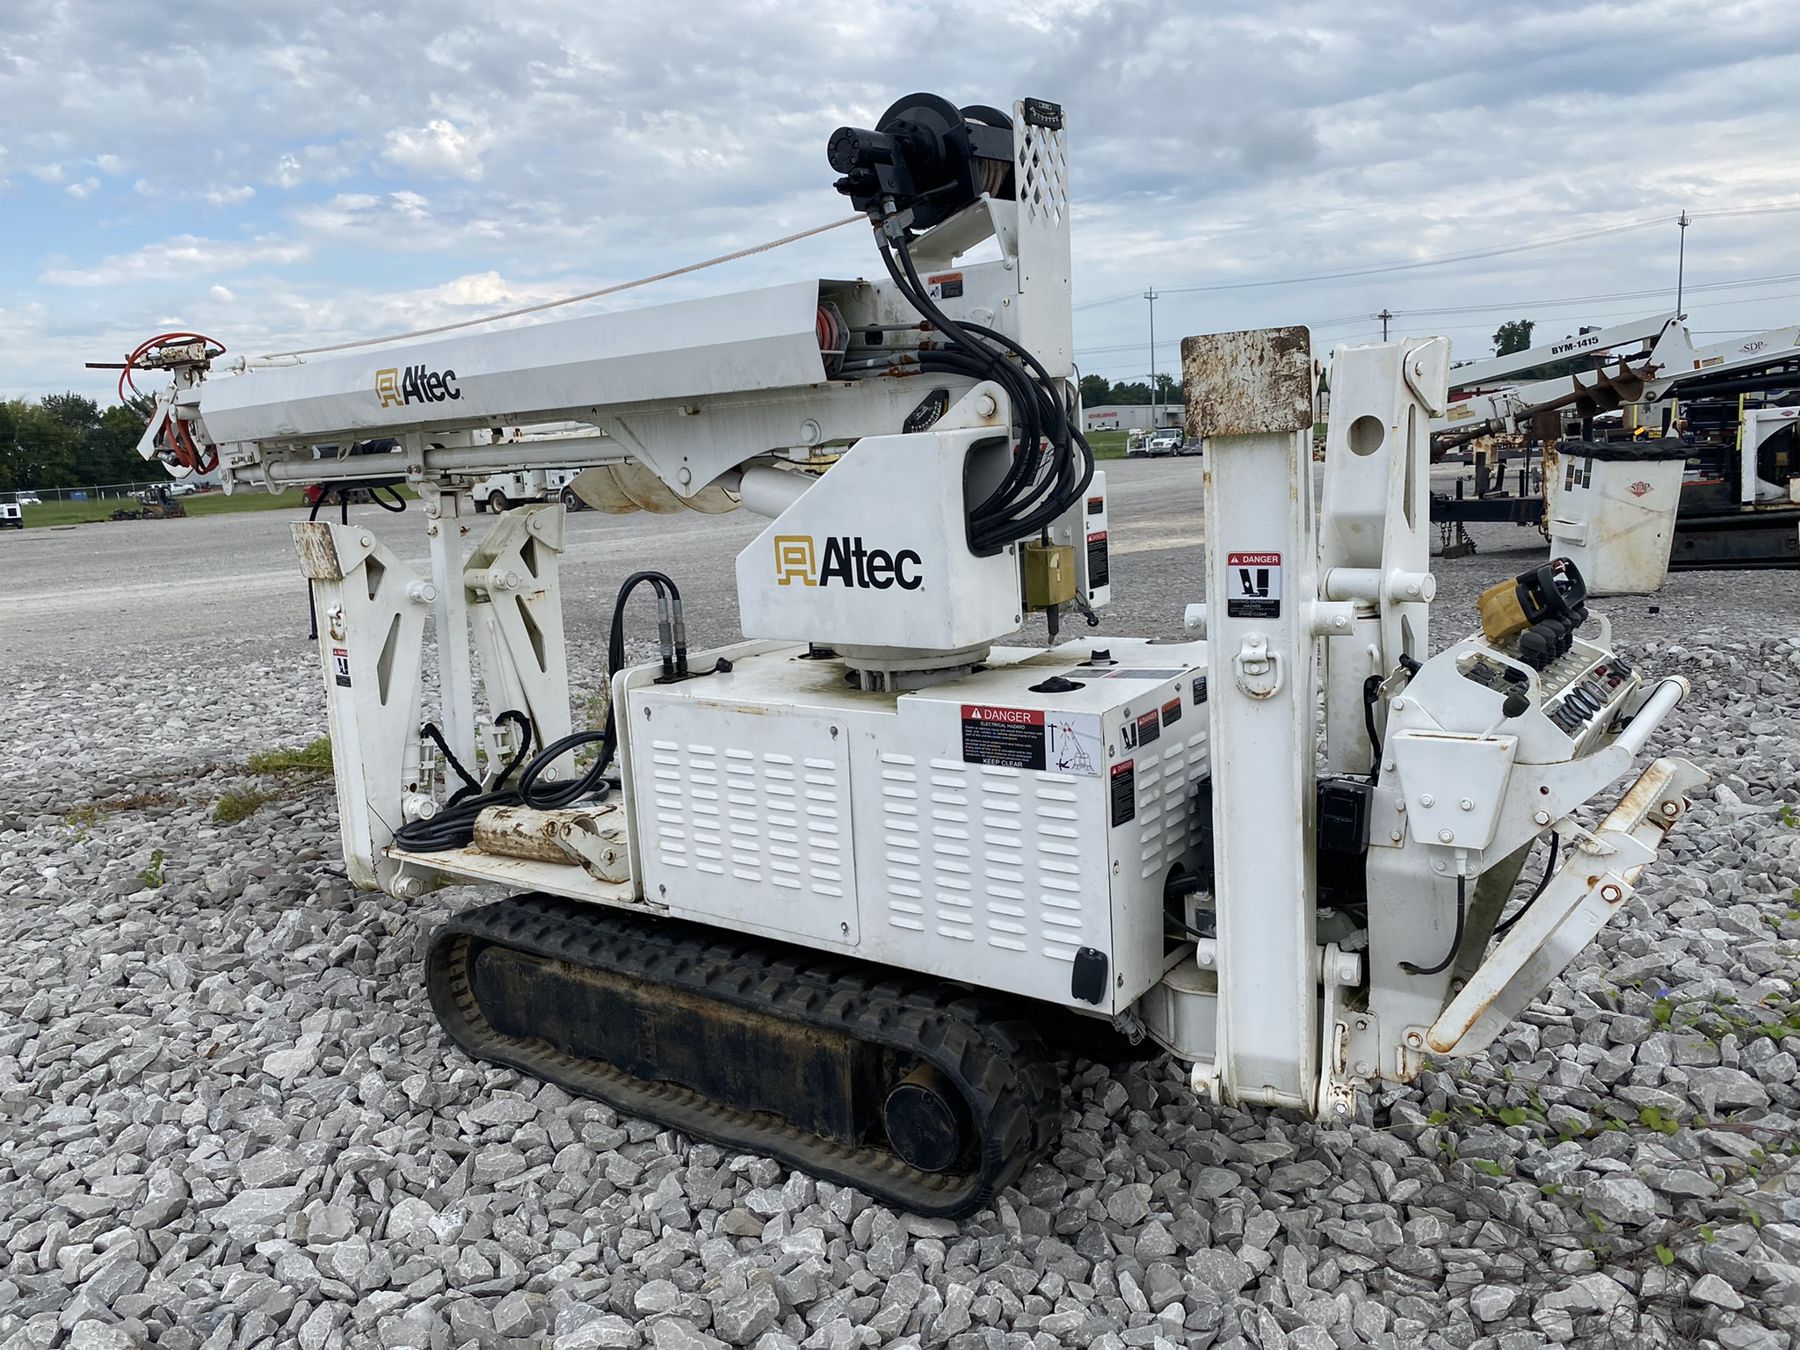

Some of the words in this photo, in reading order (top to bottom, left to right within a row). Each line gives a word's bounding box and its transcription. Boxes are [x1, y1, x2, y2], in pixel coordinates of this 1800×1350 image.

[1551, 336, 1599, 355] BYM-1415
[1743, 341, 1764, 351] SDP
[402, 364, 460, 405] Altec
[819, 536, 923, 590] Altec
[1242, 555, 1279, 563] DANGER
[984, 709, 1032, 723] DANGER
[1001, 760, 1023, 768] CLEAR
